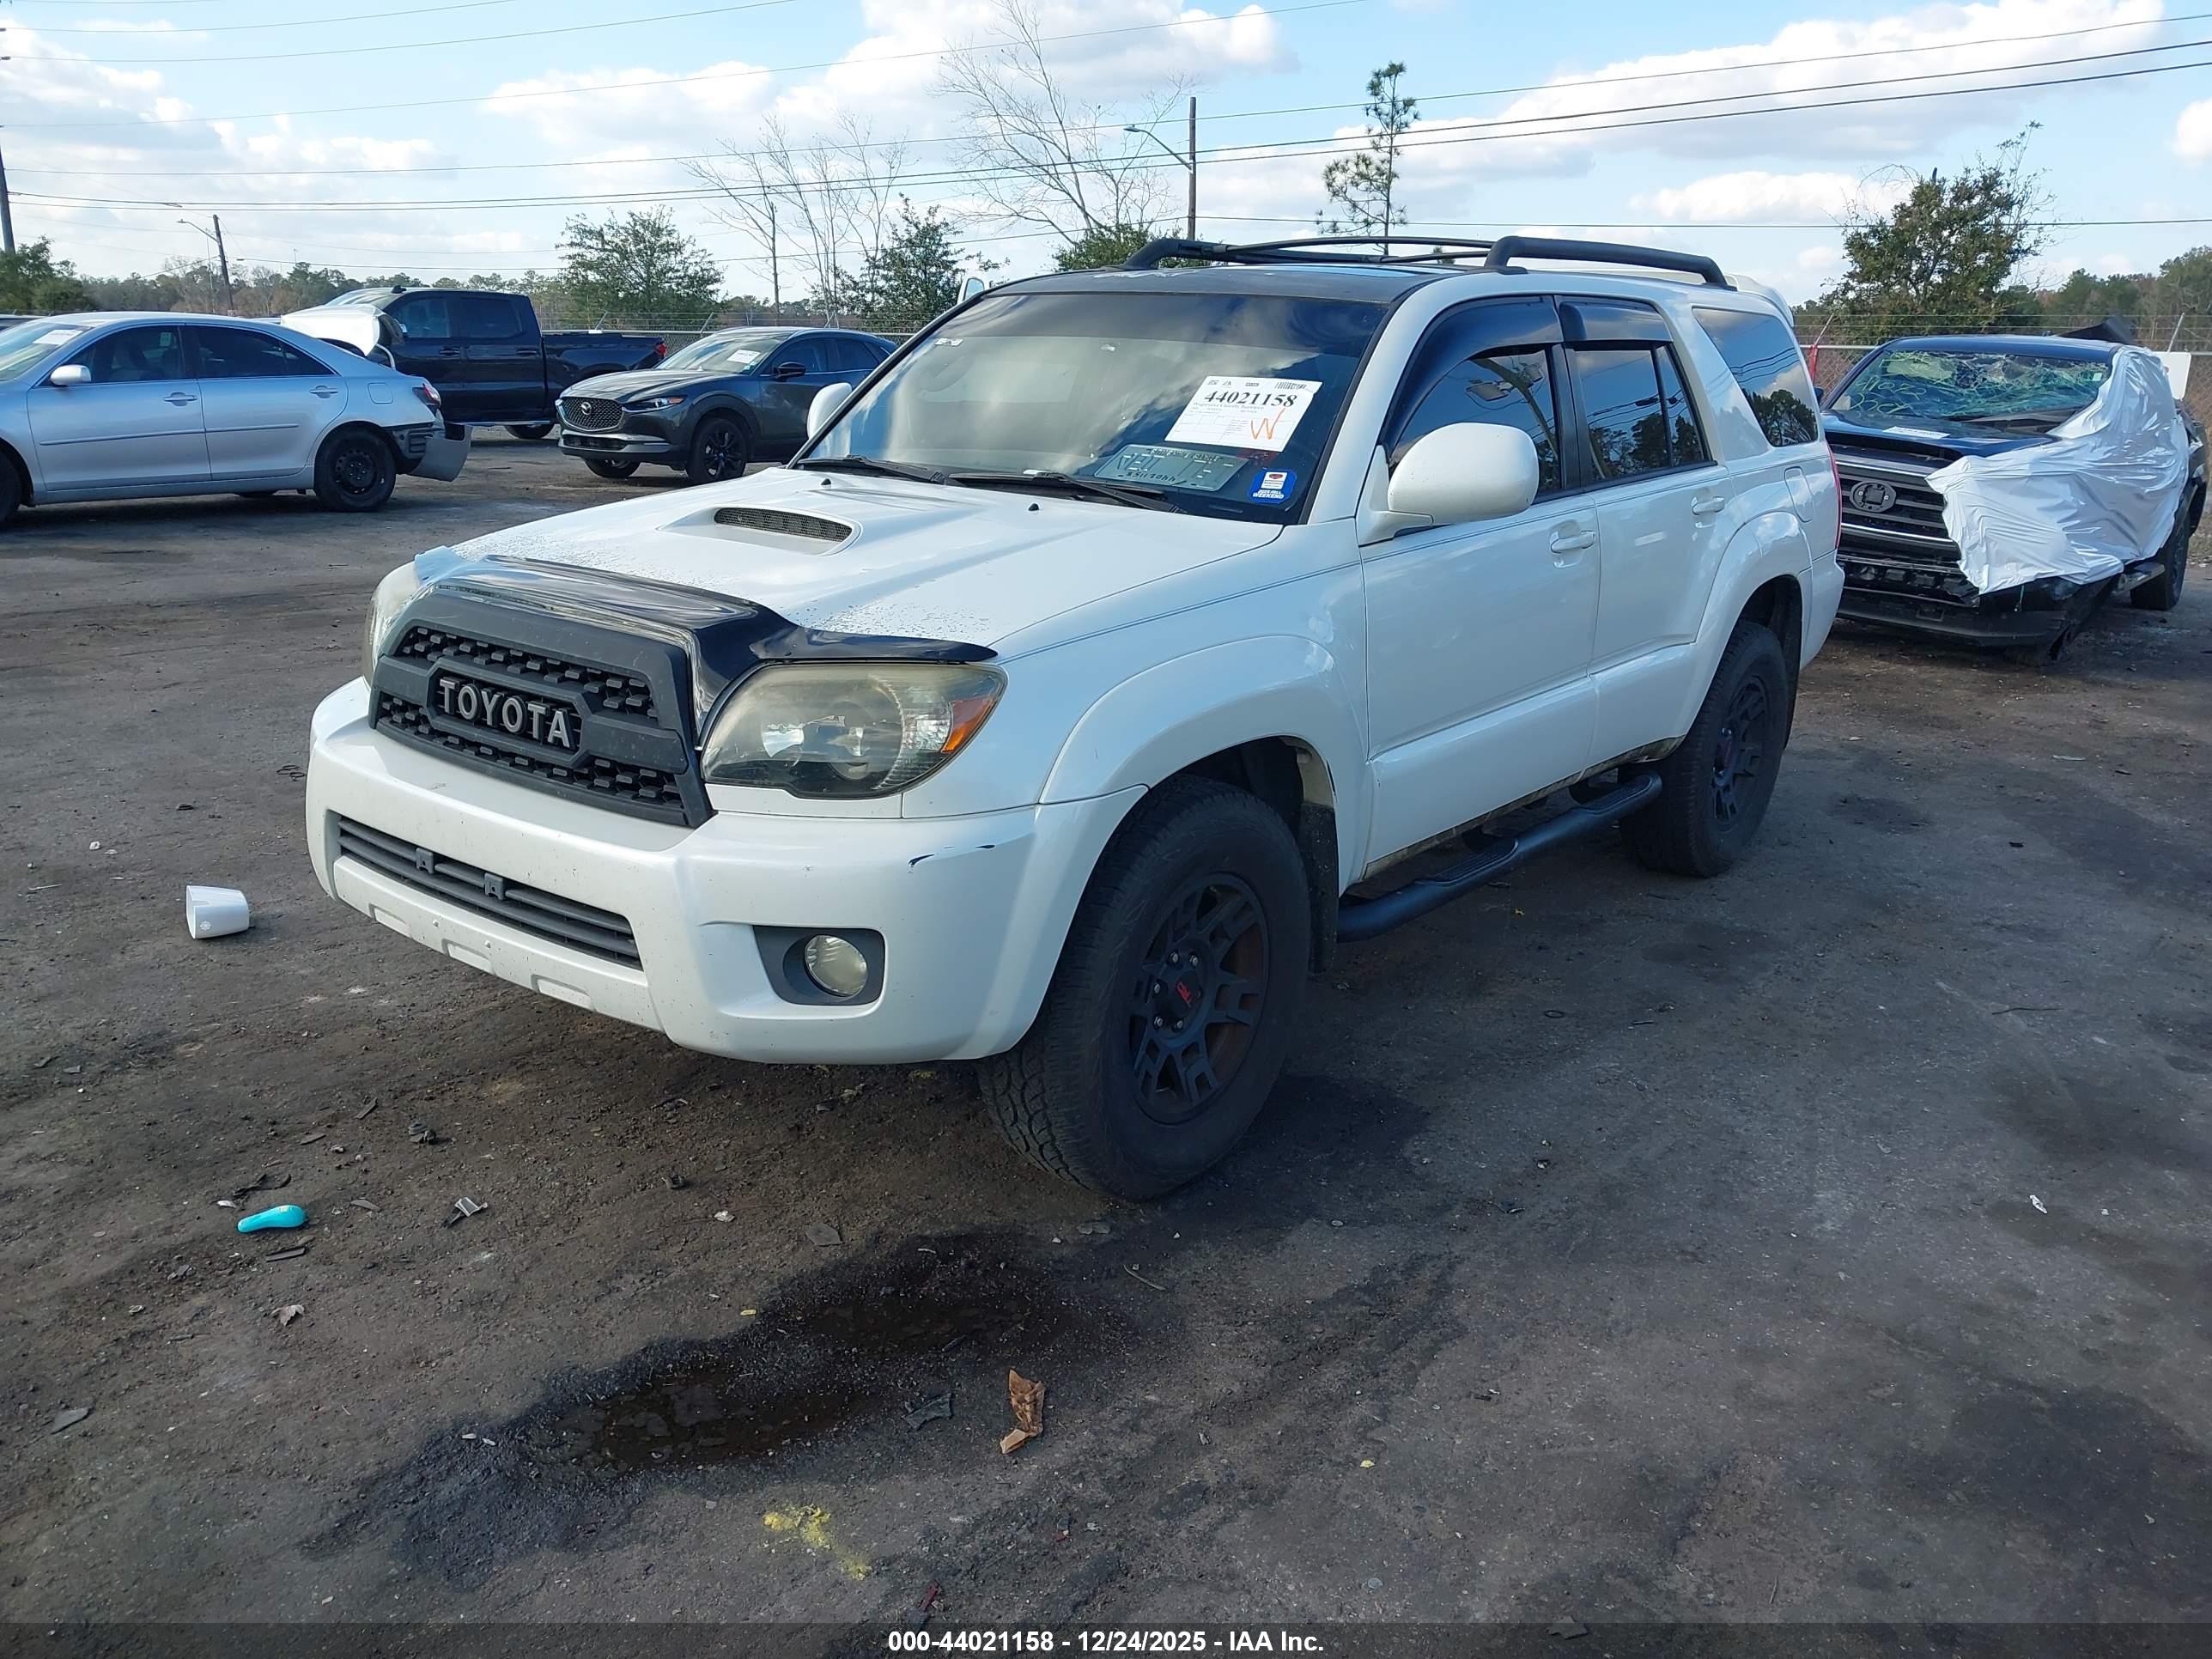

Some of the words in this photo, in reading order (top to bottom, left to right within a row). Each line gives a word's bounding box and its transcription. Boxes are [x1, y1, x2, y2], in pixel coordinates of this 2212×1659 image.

[1204, 390, 1297, 408] 44021158
[1250, 408, 1285, 441] W
[439, 677, 574, 749] TOYOTA
